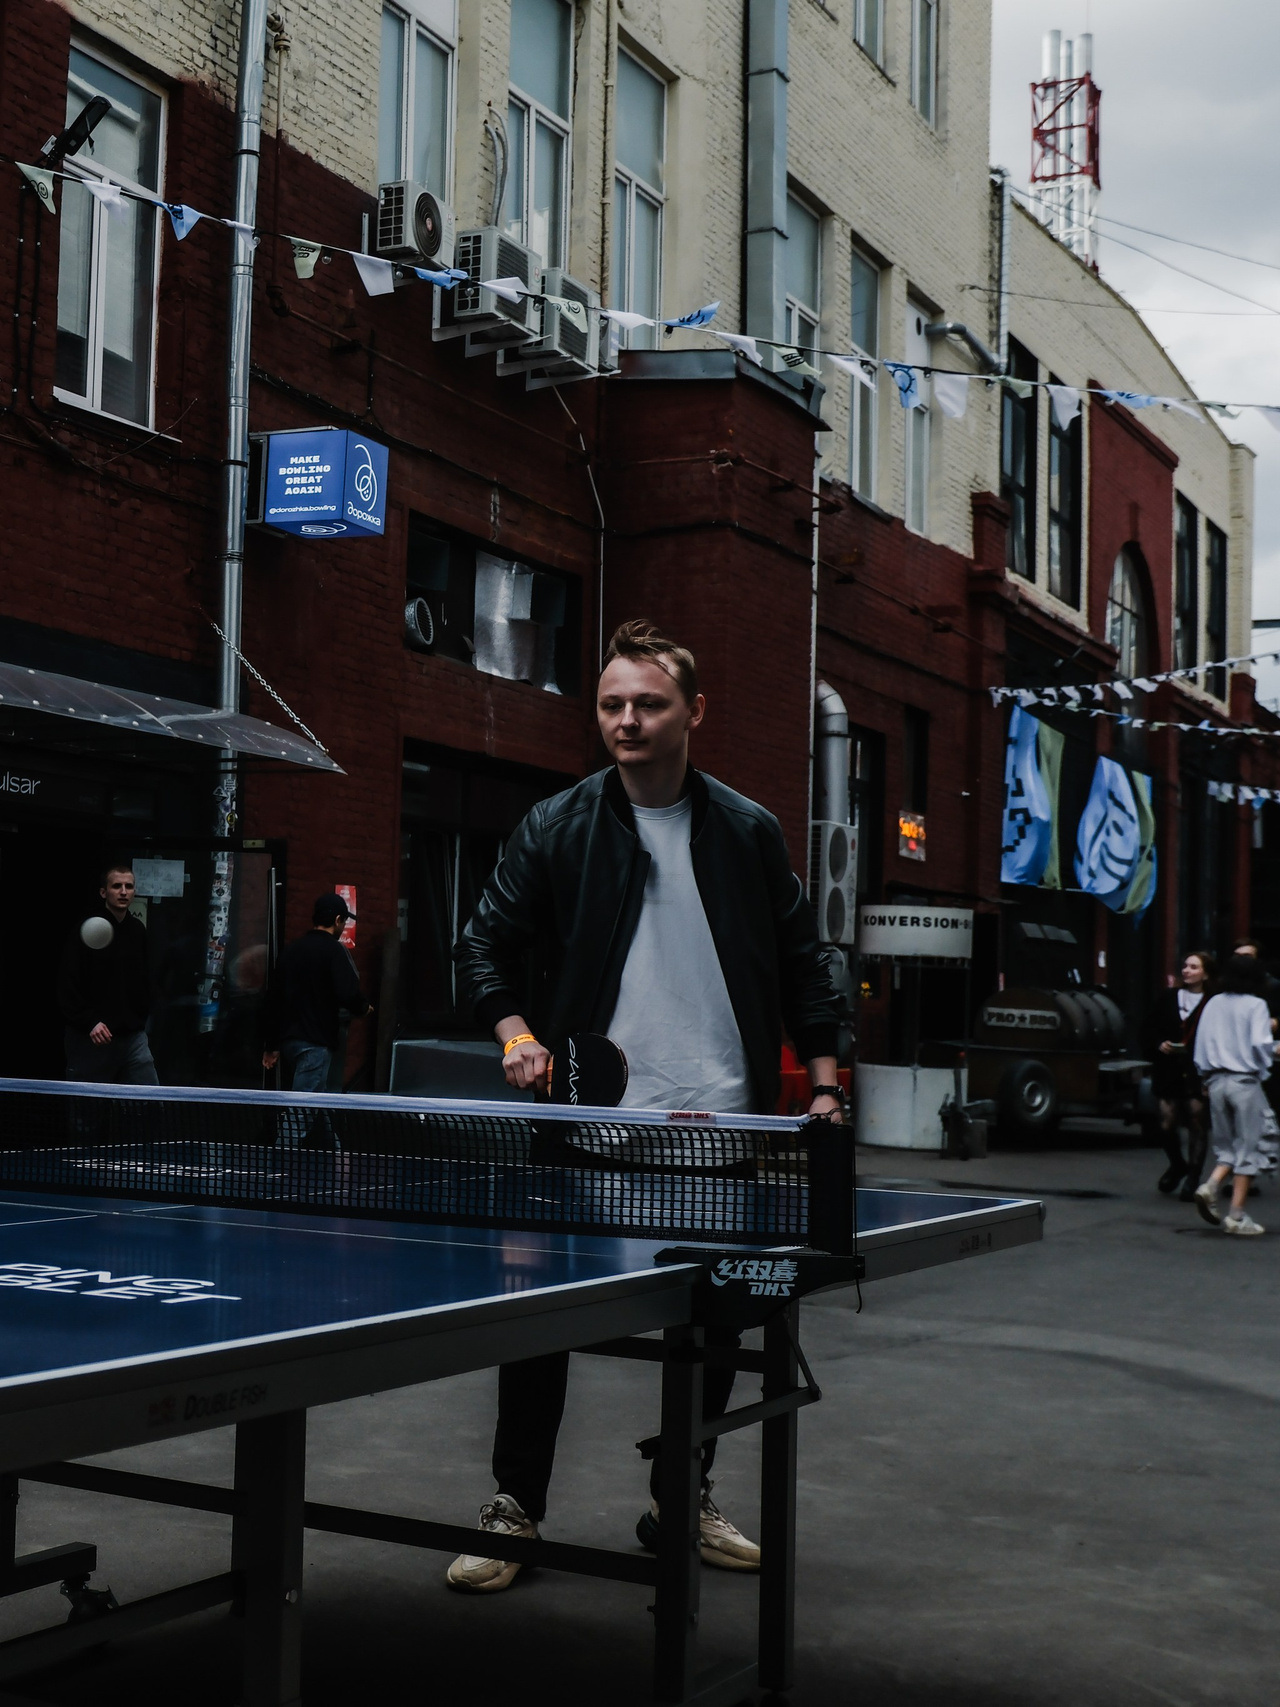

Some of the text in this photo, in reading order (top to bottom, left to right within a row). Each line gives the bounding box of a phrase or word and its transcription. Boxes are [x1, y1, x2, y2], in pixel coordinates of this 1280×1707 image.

[290, 455, 320, 464] MAKE
[278, 464, 331, 475] BOWLING
[285, 475, 323, 485] GREAT
[284, 485, 322, 495] AGAIN
[269, 504, 336, 514] @dorozhka.bowling
[347, 501, 381, 526] дорожка
[987, 1011, 1057, 1026] PRO BBQ
[711, 1258, 799, 1287] 红双喜
[748, 1282, 796, 1297] DHS
